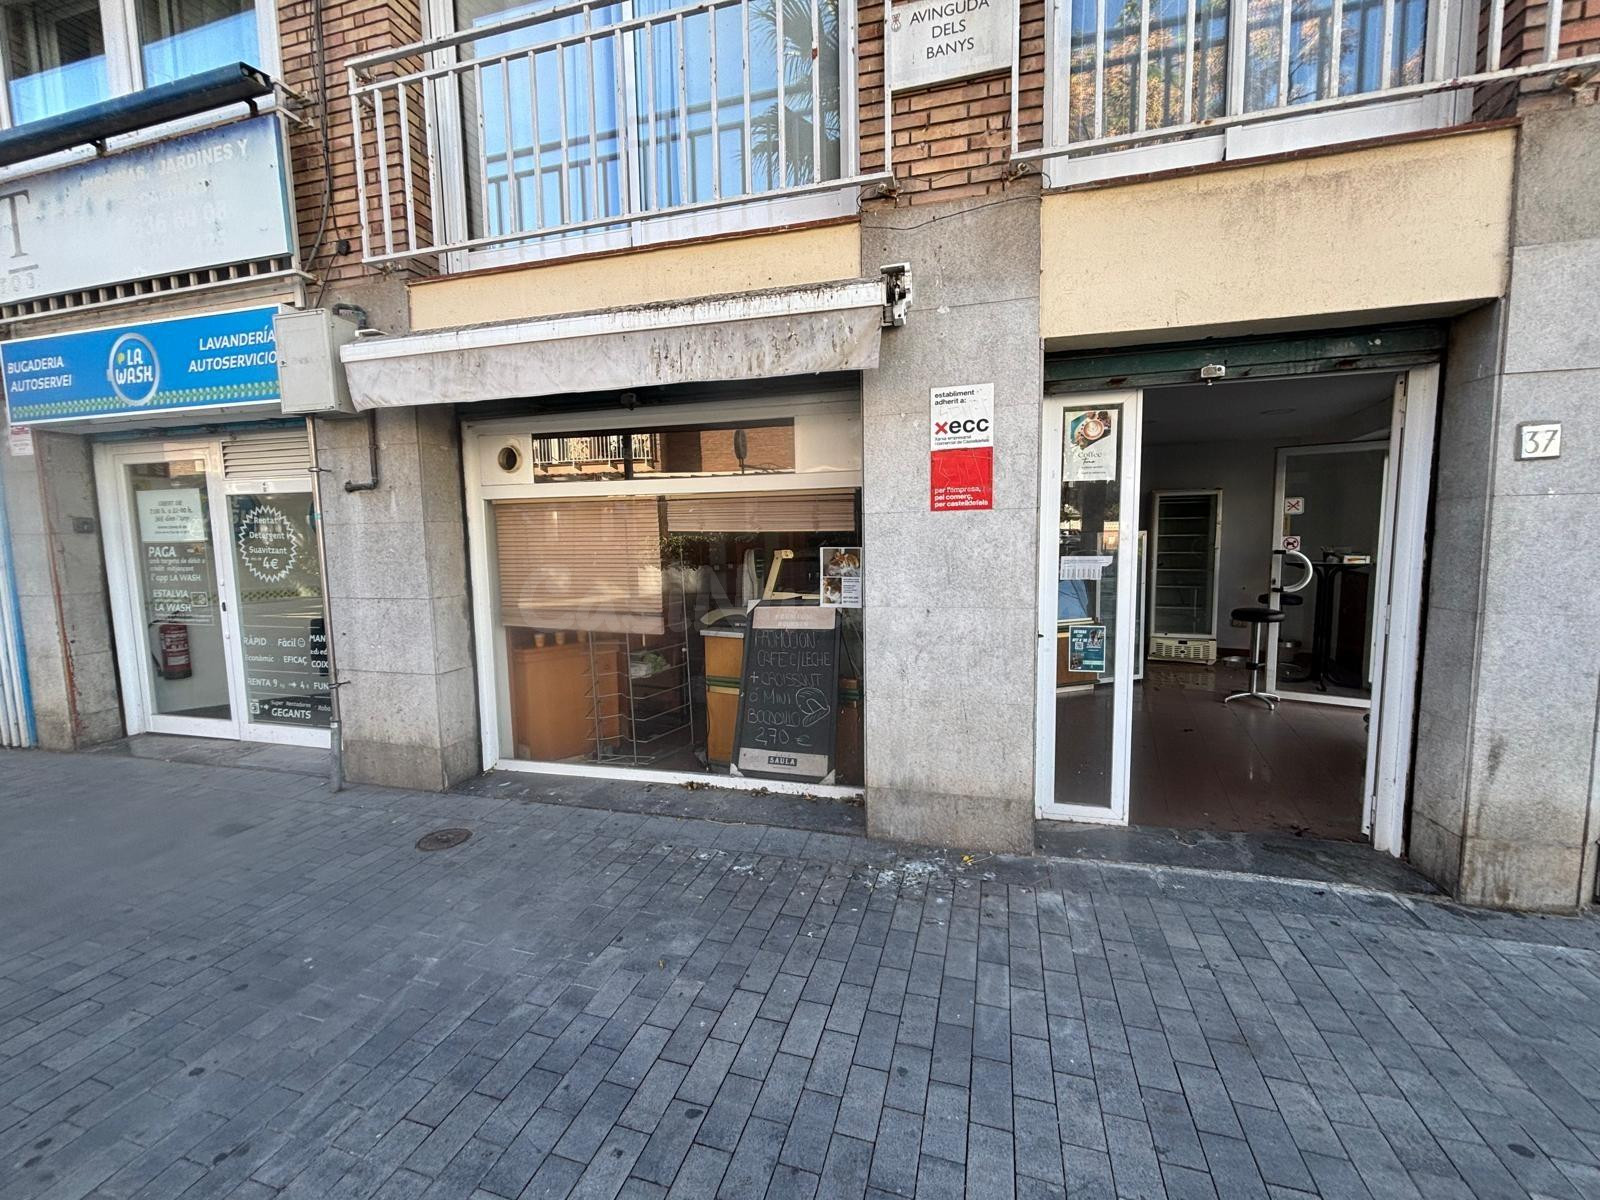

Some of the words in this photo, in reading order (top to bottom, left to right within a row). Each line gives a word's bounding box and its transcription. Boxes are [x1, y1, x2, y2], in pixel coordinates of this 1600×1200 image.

[909, 0, 990, 25] AVINGUDA
[932, 19, 966, 38] DELS
[926, 37, 974, 59] BANYS
[199, 324, 276, 351] LAVANDERÍA
[7, 356, 64, 374] BUGADERIA
[126, 348, 144, 365] LA
[188, 350, 277, 373] AUTOSERVICIO
[10, 374, 72, 393] AUTOSERVEI
[115, 365, 154, 385] WASH
[934, 389, 975, 398] establiment
[935, 418, 989, 435] xecc
[1525, 429, 1558, 454] 37
[249, 531, 285, 541] Detergent
[148, 546, 177, 557] PAGA
[249, 546, 287, 554] Suavitzant
[262, 557, 279, 569] 4€
[166, 603, 192, 612] WASH
[271, 707, 312, 719] GEGANTS
[769, 756, 796, 766] SAULA
